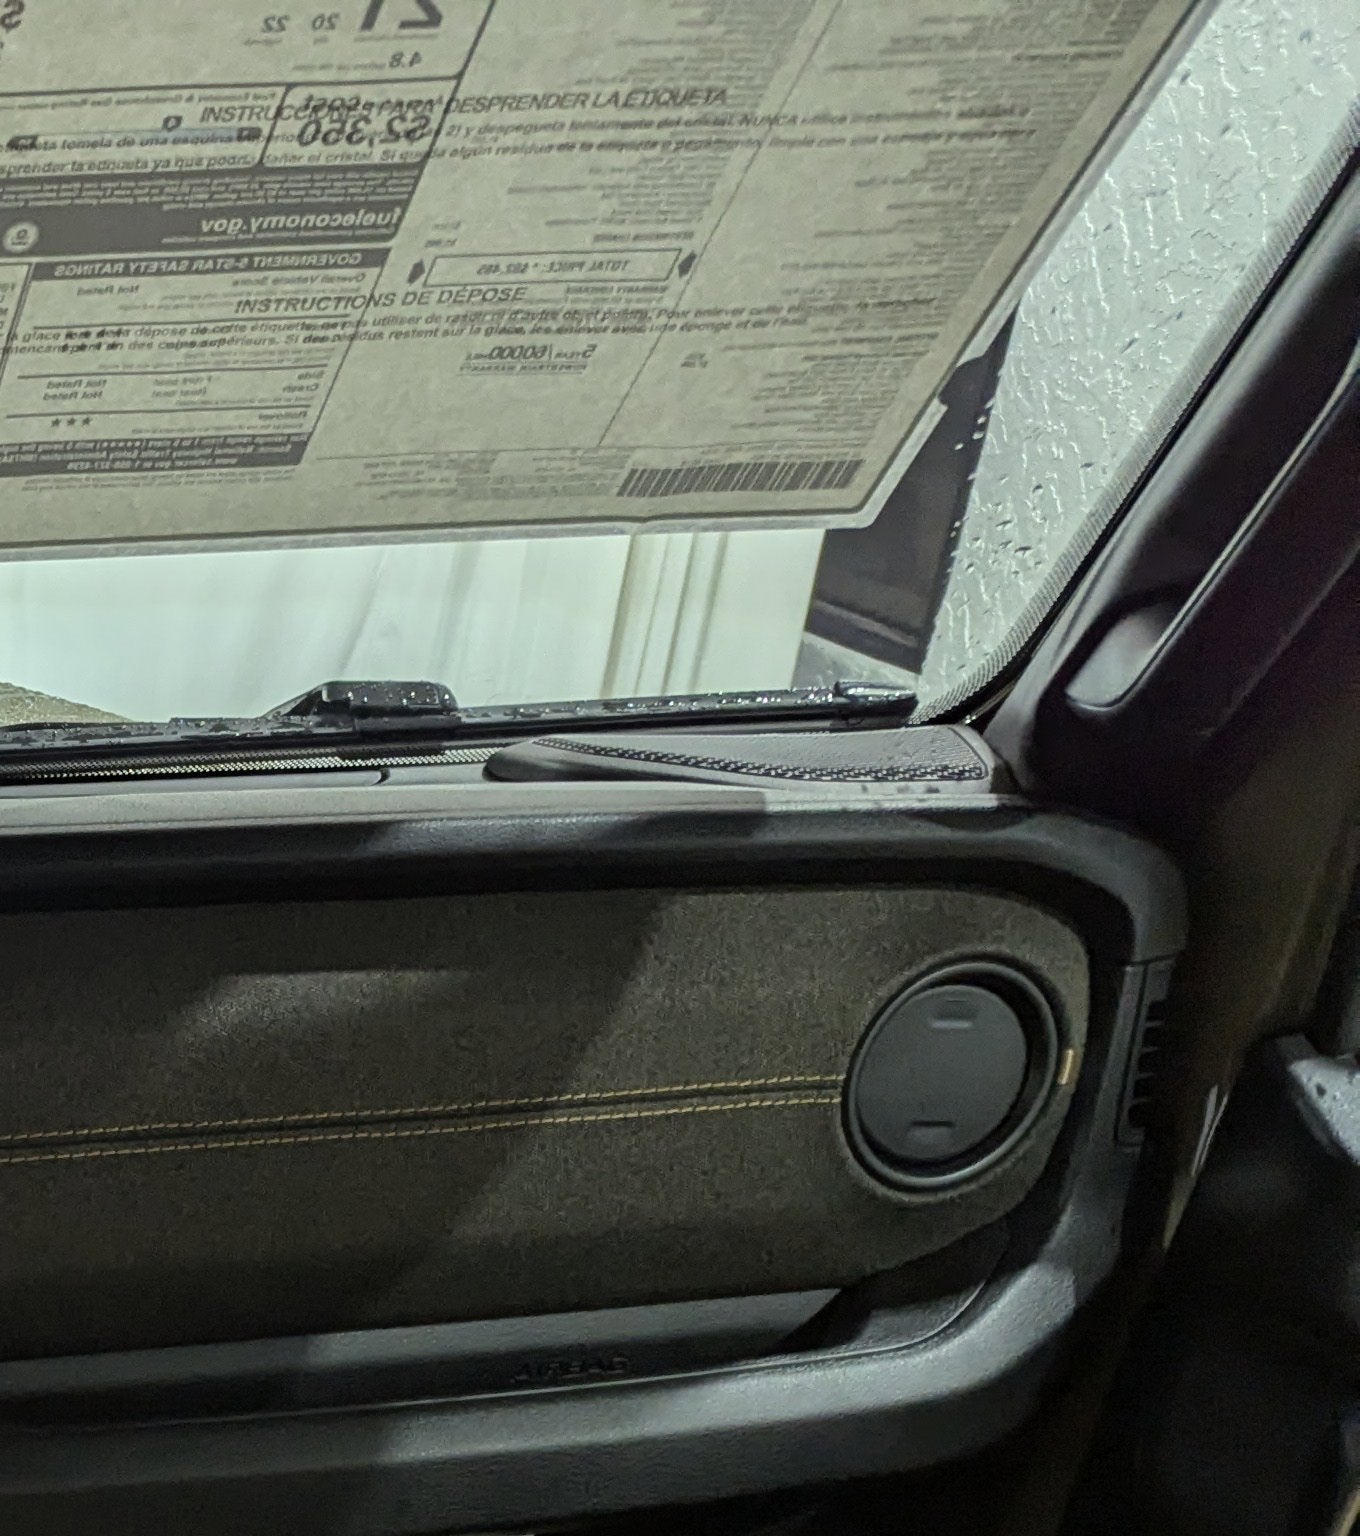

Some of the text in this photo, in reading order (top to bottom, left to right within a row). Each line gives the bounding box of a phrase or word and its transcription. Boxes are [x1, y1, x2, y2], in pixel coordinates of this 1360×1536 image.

[449, 91, 590, 113] DESPRENDER
[592, 90, 620, 108] LA
[234, 286, 528, 314] INSTRUCTIONS DE DÉPOSE
